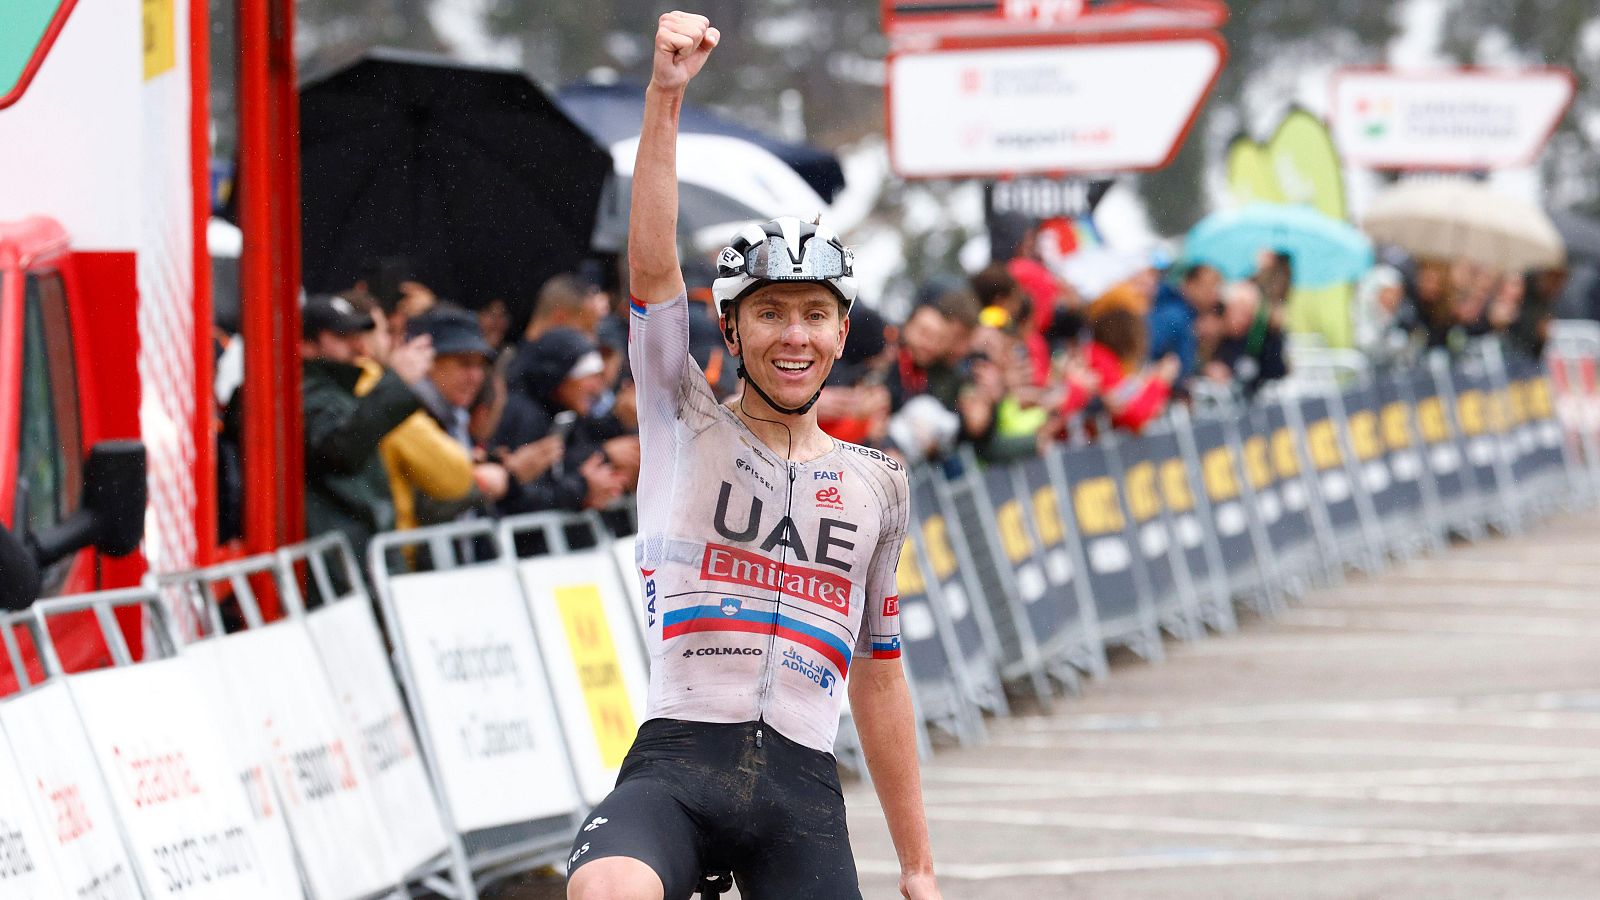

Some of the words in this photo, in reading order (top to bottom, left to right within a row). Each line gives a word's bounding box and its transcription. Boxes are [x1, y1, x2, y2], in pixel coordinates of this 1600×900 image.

[744, 464, 775, 492] PISSEI
[713, 480, 858, 573] UAE
[706, 548, 847, 609] Emirates
[696, 647, 763, 657] COLNAGO
[781, 659, 821, 684] ADNOC
